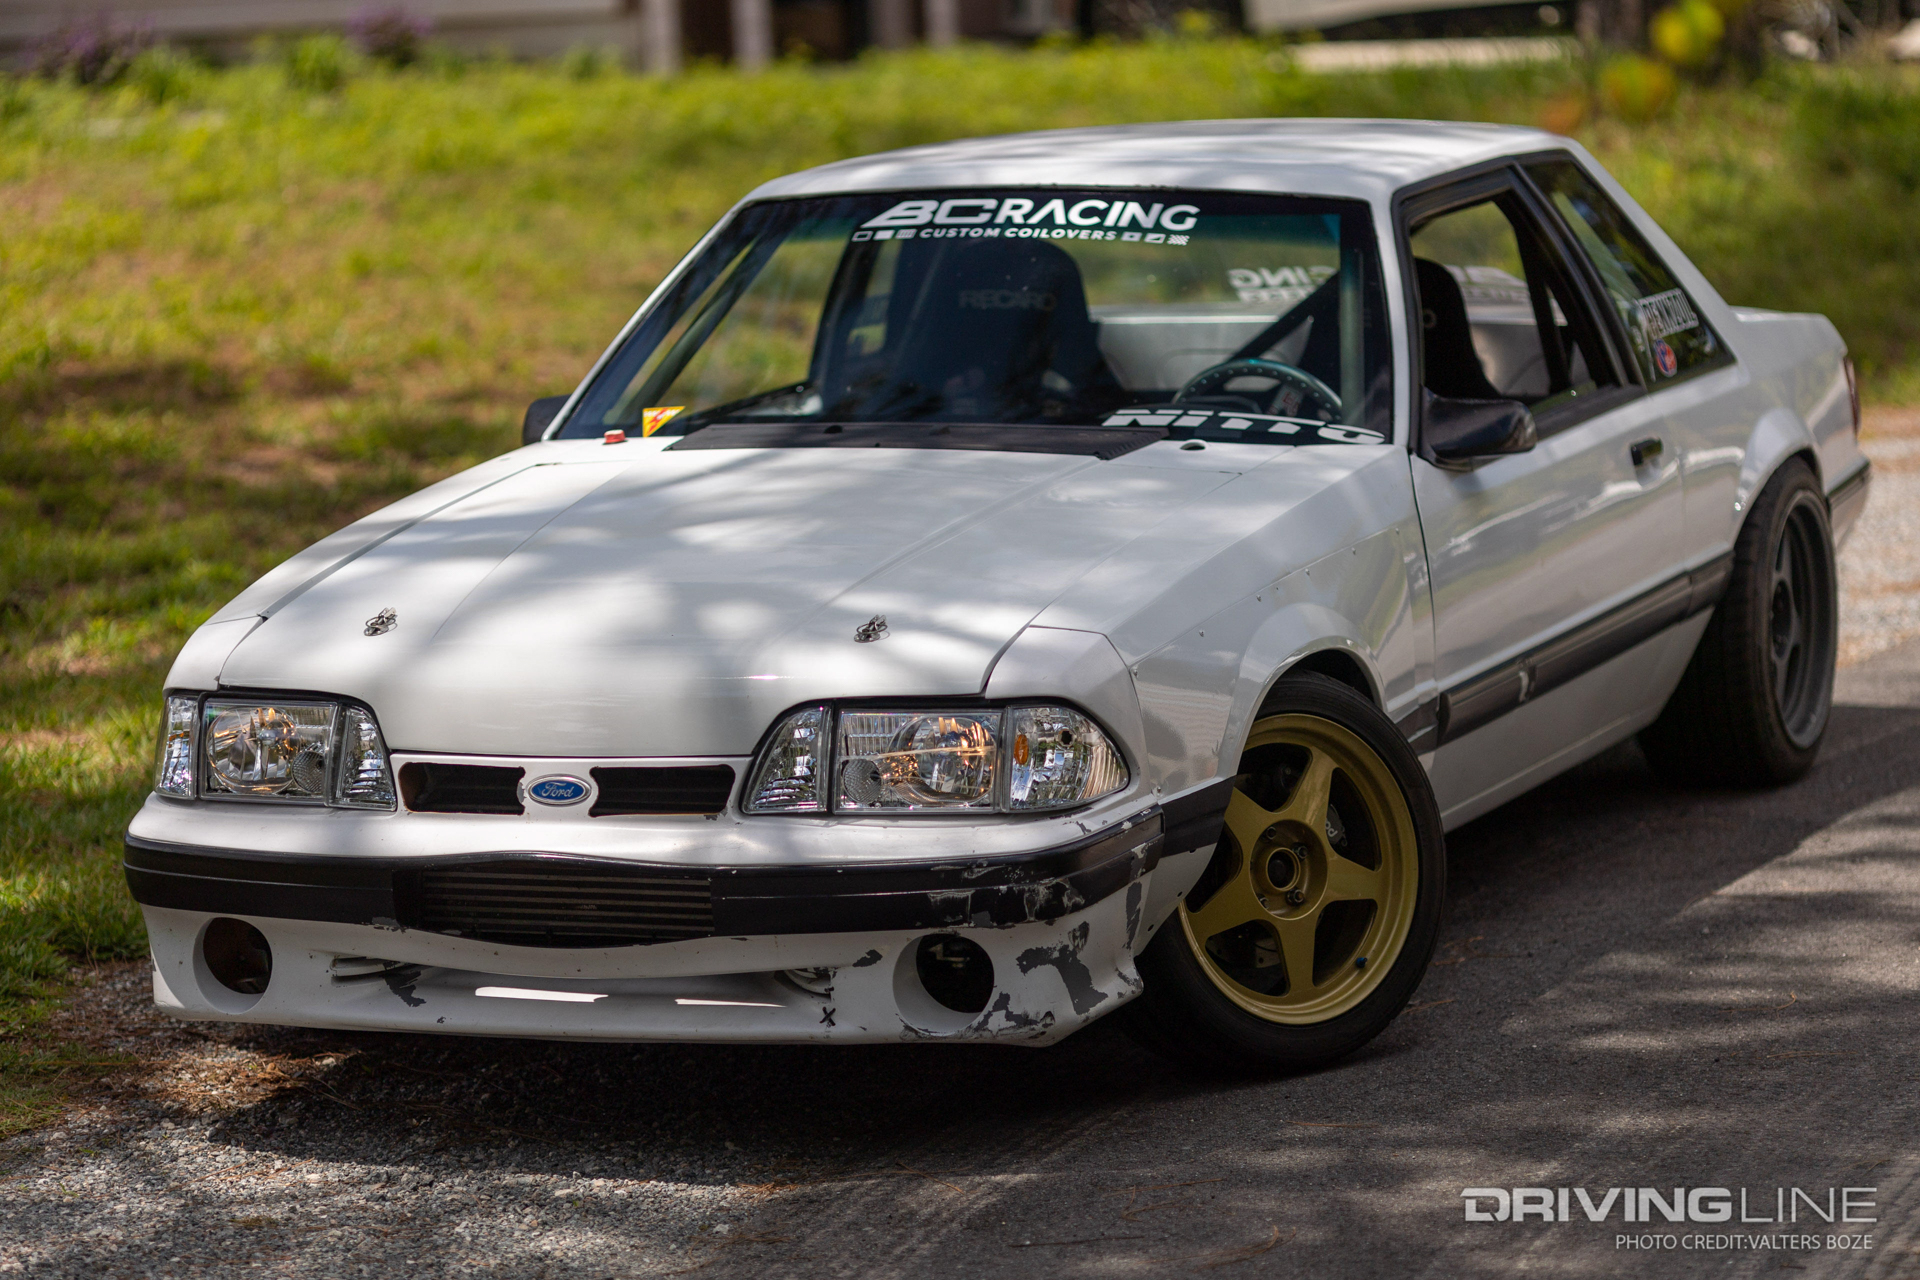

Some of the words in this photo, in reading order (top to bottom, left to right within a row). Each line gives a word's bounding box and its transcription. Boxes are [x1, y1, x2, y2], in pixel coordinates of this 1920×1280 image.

[919, 227, 1001, 239] CUSTOM
[1004, 227, 1118, 241] COILOVERS
[541, 781, 575, 797] Ford
